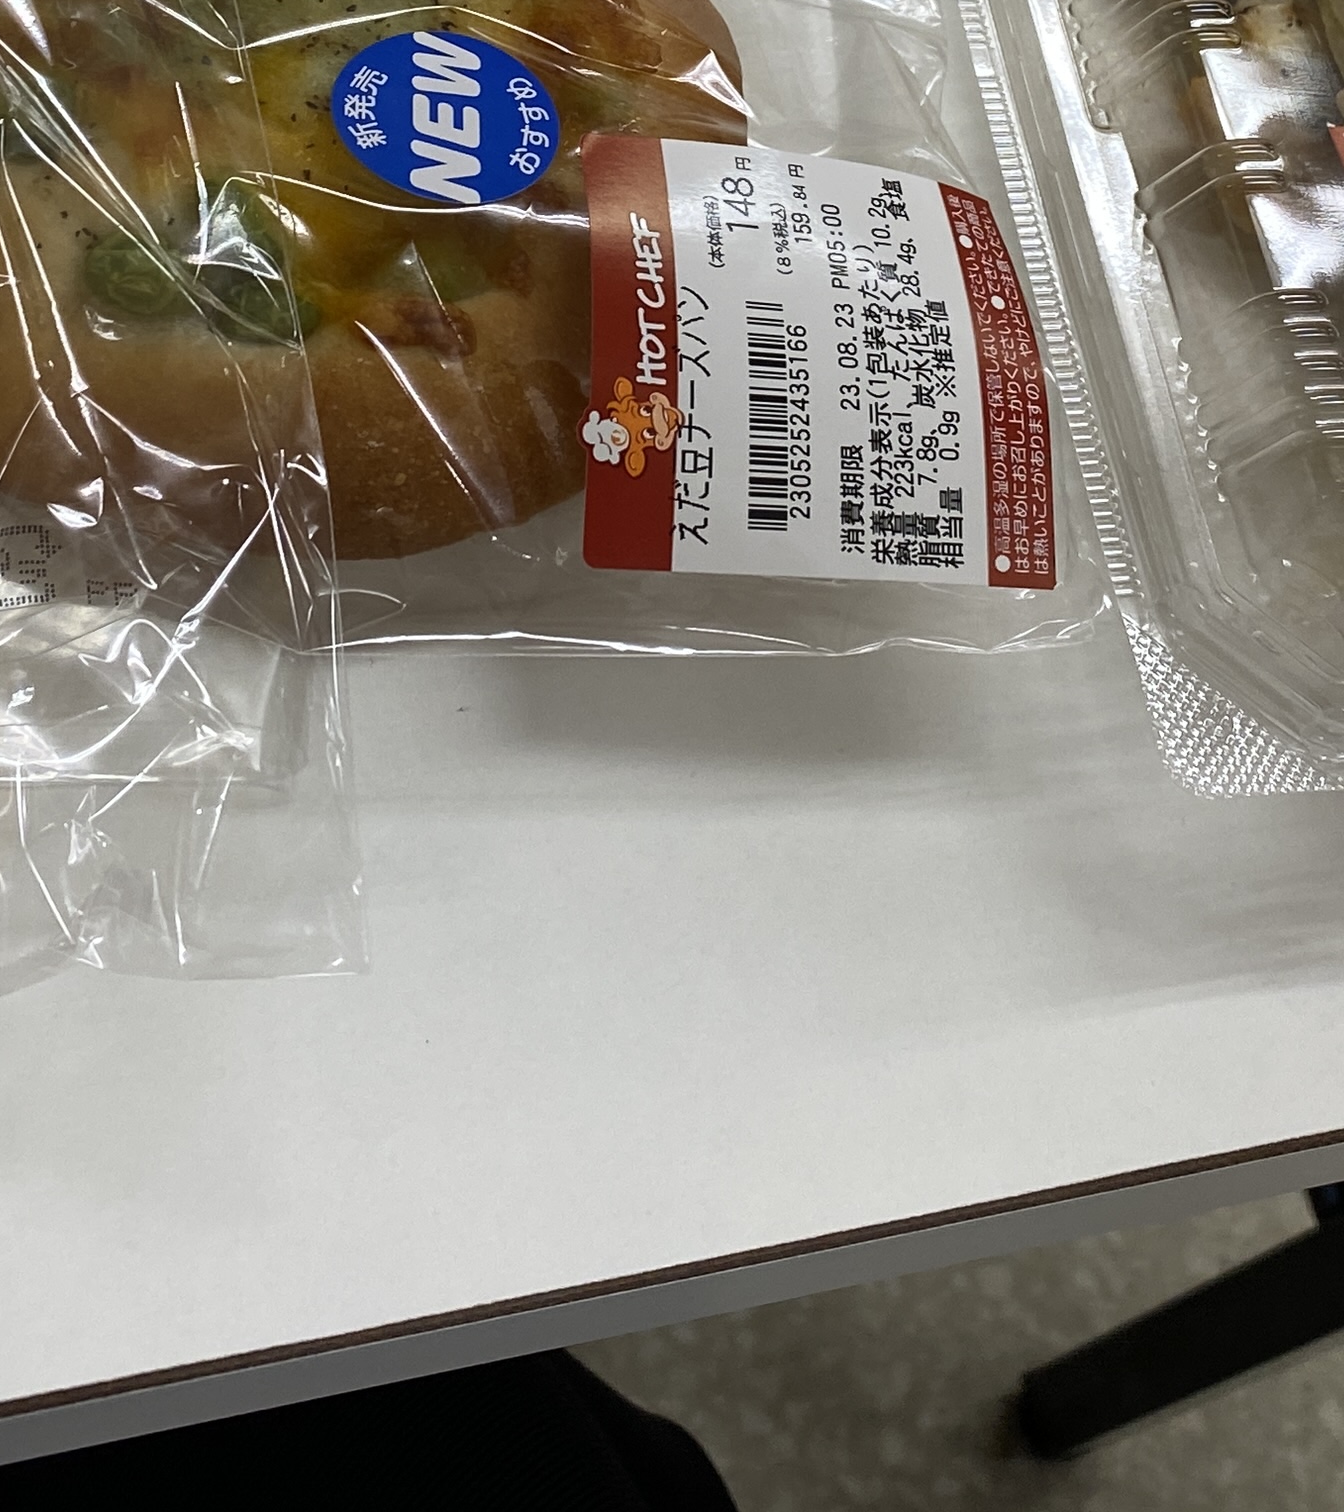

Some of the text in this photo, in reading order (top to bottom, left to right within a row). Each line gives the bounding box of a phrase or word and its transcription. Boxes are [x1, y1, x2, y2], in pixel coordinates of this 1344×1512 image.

[343, 65, 389, 150] 新発売
[409, 31, 482, 205] NEW
[507, 77, 551, 176] おすすめ
[702, 195, 727, 268] (本体価格)
[721, 176, 760, 233] 148
[768, 202, 794, 275] (8%税込)
[629, 211, 668, 386] HOT CHEF
[669, 285, 714, 546] えだ豆チーズパン
[785, 324, 812, 520] 2305252435166
[820, 204, 866, 554] 消費期限 23.08.23 PM05:00
[852, 244, 896, 566] 栄養成分表示(1包装あたり)
[937, 410, 961, 462] 0.9g
[938, 487, 965, 569] 相当量
